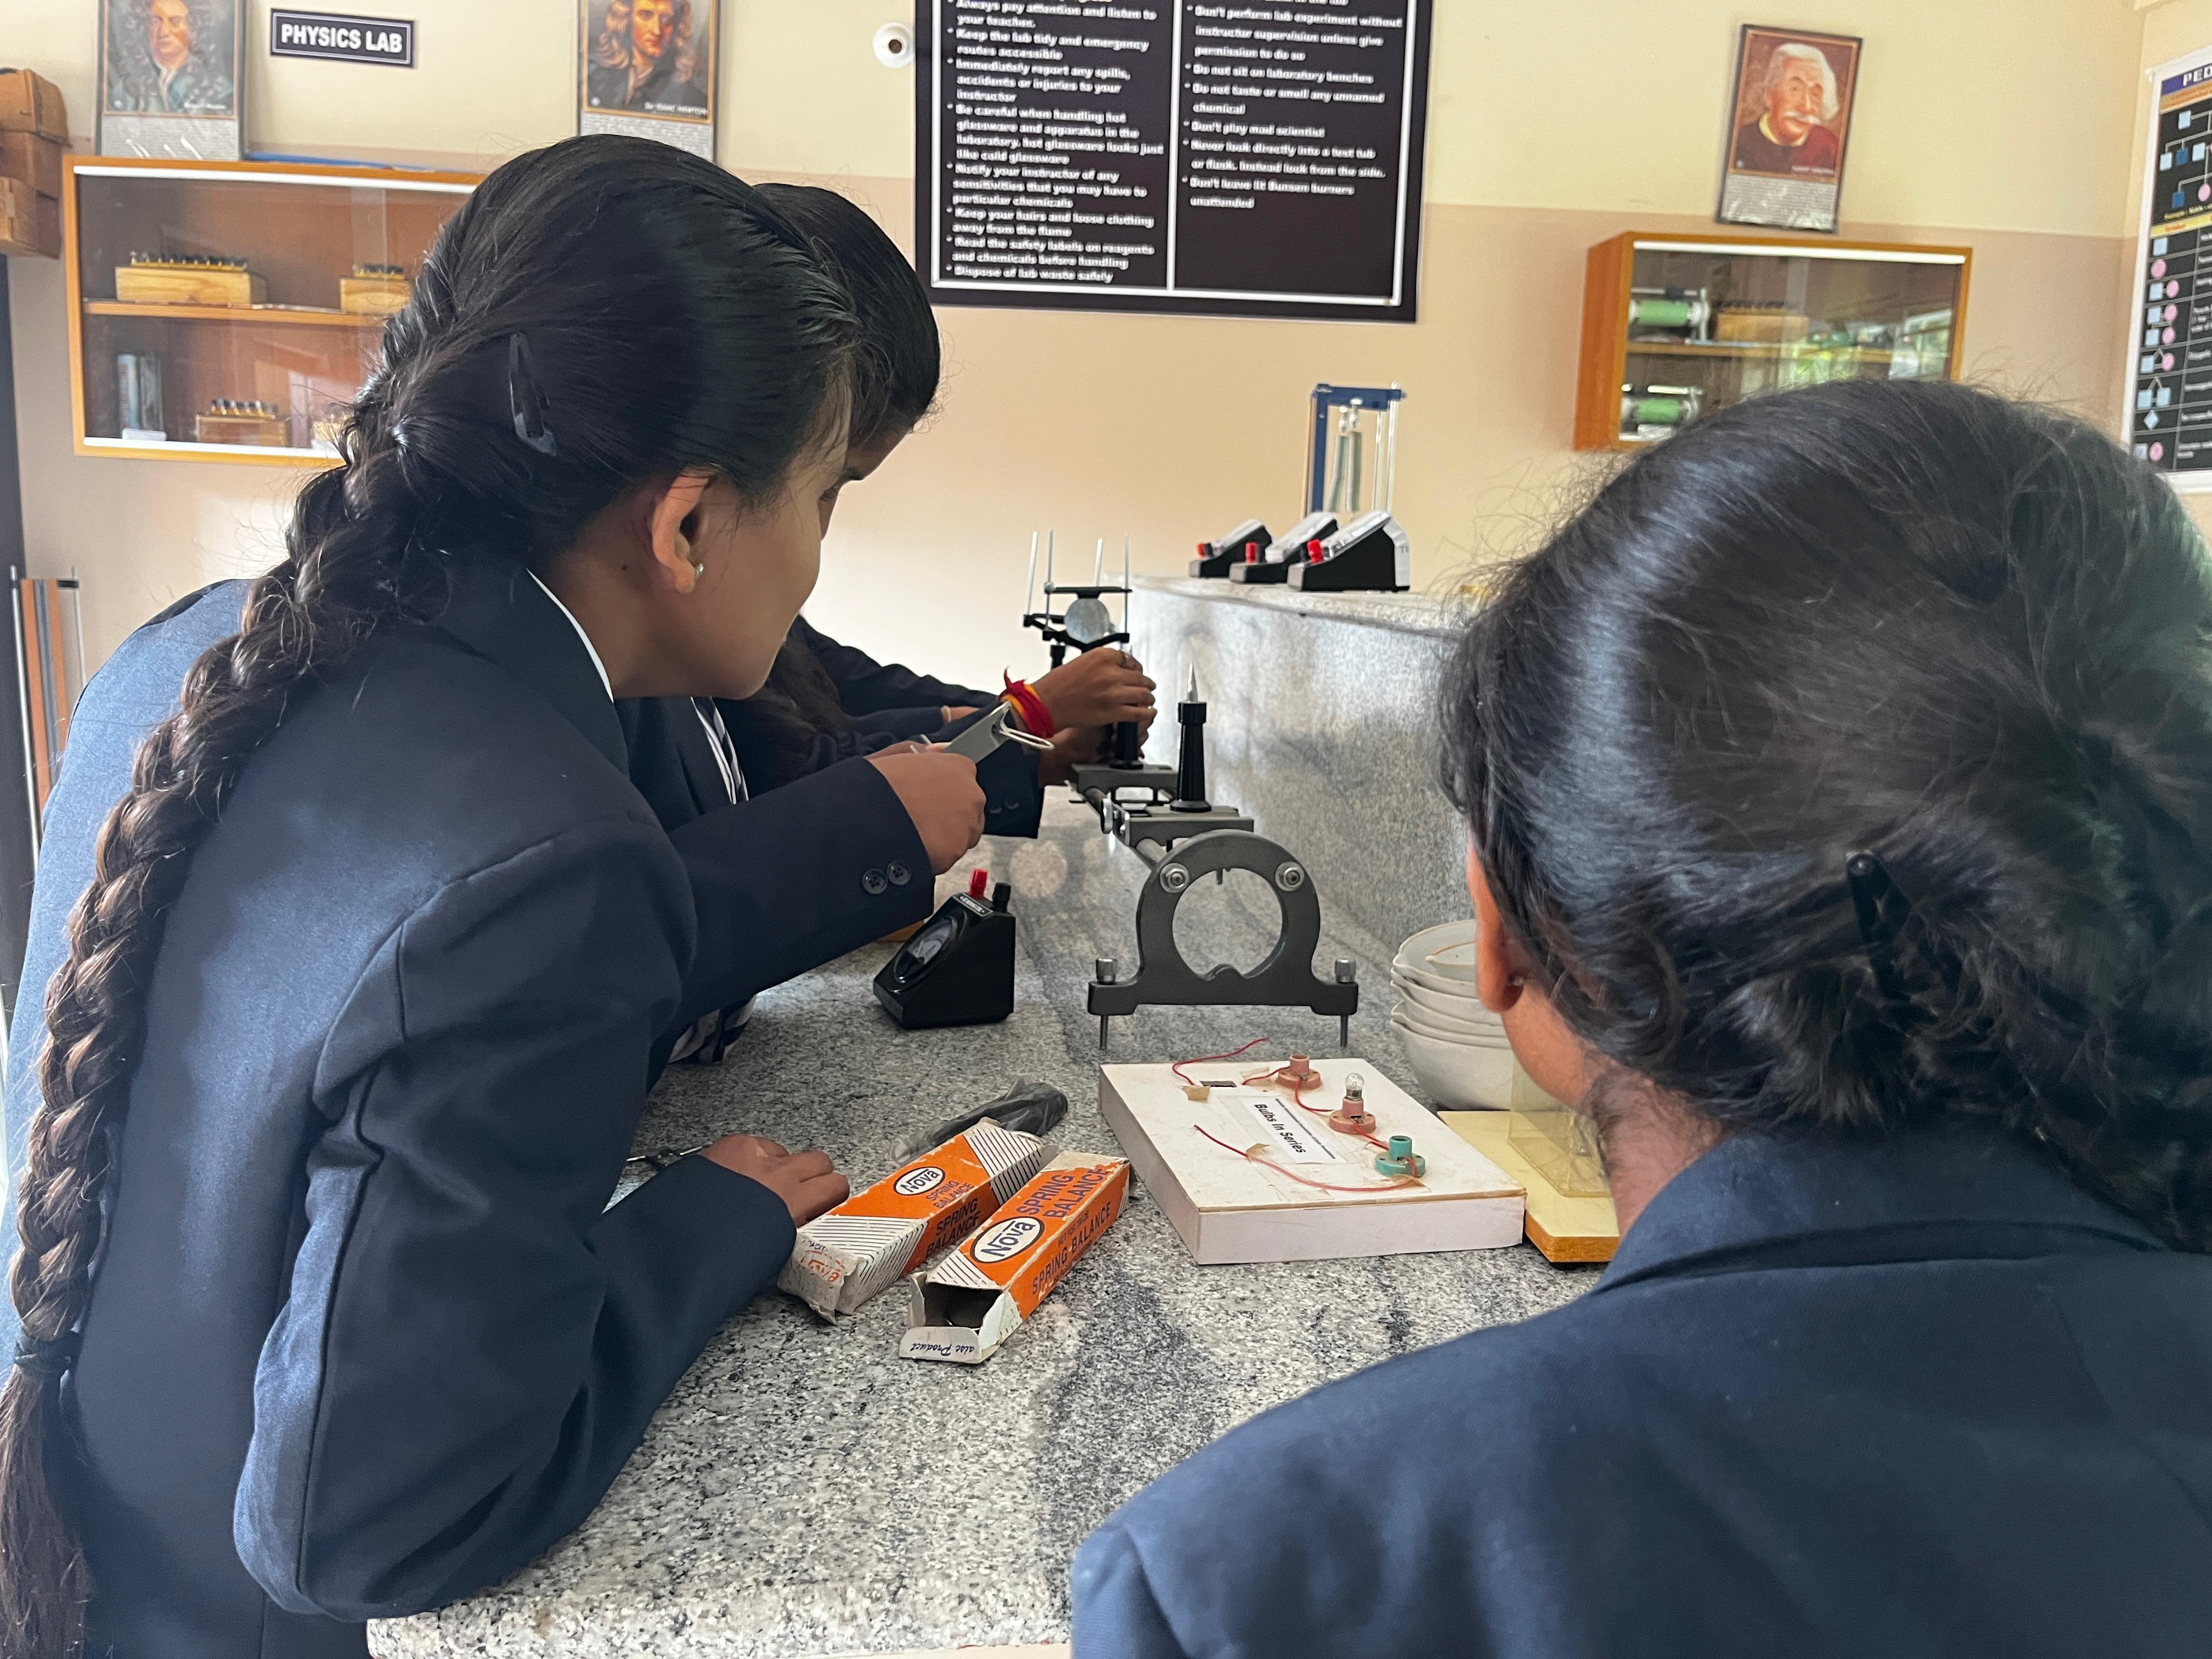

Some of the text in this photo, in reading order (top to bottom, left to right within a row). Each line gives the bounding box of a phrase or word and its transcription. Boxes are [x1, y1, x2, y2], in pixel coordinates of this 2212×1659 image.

[957, 15, 984, 25] your
[1002, 3, 1025, 14] pay
[1026, 3, 1081, 15] attention
[1082, 7, 1105, 17] and
[1107, 7, 1141, 19] listen
[1143, 10, 1156, 20] to
[1195, 5, 1402, 27] Don't perform lab experiment without
[281, 24, 403, 53] PHYSICS LAB
[956, 28, 1149, 52] Keep the lab tidy and emergency
[1195, 25, 1252, 38] instructor
[1254, 30, 1319, 42] supervision
[1321, 34, 1358, 44] unless
[998, 48, 1063, 60] accessible
[1195, 47, 1258, 58] permission
[1260, 49, 1272, 59] to
[1274, 49, 1289, 60] do
[956, 59, 1030, 75] Immediately
[1031, 66, 1069, 76] report
[1071, 67, 1093, 78] any
[1193, 64, 1210, 74] Do
[1211, 66, 1231, 76] not
[1233, 66, 1248, 77] sit
[1267, 68, 1325, 83] laboratory
[1327, 72, 1374, 83] benches
[957, 76, 1016, 87] accidents
[1079, 82, 1093, 92] to
[1094, 84, 1121, 94] your
[1193, 83, 1209, 93] Do
[1211, 85, 1230, 95] not
[1232, 86, 1262, 96] taste
[1278, 88, 1309, 99] smell
[1311, 92, 1332, 103] any
[1333, 93, 1385, 103] unnamed
[957, 89, 1017, 102] instructor
[956, 104, 1126, 124] Be careful when handling hot
[1193, 103, 1245, 114] chemical
[957, 120, 1018, 132] glassware
[1020, 123, 1042, 133] and
[1044, 126, 1103, 137] apparatus
[1119, 128, 1139, 139] the
[1192, 121, 1325, 137] Don't play mad scientist
[1023, 137, 1043, 148] hot
[1045, 139, 1105, 151] glassware
[1107, 142, 1139, 153] looks
[1140, 144, 1164, 155] just
[1191, 140, 1224, 151] Never
[1226, 142, 1251, 152] look
[1252, 143, 1296, 157] directly
[1297, 145, 1321, 156] into
[1332, 148, 1355, 157] test
[957, 149, 1069, 164] like cold glassware
[956, 163, 1119, 183] Notify your instructor of any
[1283, 163, 1308, 174] look
[1310, 165, 1336, 175] from
[1338, 166, 1357, 177] the
[953, 180, 1147, 197] sensitivities that you may have to
[1190, 177, 1220, 188] Don't
[1221, 179, 1252, 190] leave
[1268, 181, 1310, 193] Bunsen
[953, 195, 1073, 208] particular chemicals
[1190, 198, 1254, 208] unattended
[955, 207, 986, 221] Keep
[988, 211, 1014, 221] your
[1048, 213, 1071, 222] and
[1073, 213, 1105, 224] loose
[1107, 215, 1154, 228] clothing
[952, 224, 1071, 236] away from the flame
[955, 236, 985, 247] Read
[987, 238, 1007, 249] the
[1009, 240, 1046, 252] safety
[1048, 241, 1084, 251] labels
[1103, 245, 1154, 255] reagents
[952, 252, 1128, 269] and chemicals before handling
[955, 265, 1113, 283] Dispose of lab waste safely
[1254, 1104, 1278, 1122] Bulbs
[1279, 1132, 1306, 1153] Series
[900, 1169, 940, 1193] Nova
[926, 1180, 960, 1201] SPRING
[1016, 1175, 1075, 1216] SPRING
[1042, 1168, 1110, 1218] BALANCE
[936, 1197, 978, 1236] SPRING
[980, 1221, 1037, 1257] Nova
[1032, 1246, 1068, 1296] SPRING
[1071, 1201, 1111, 1254] BALANCE
[910, 1342, 952, 1356] Product
